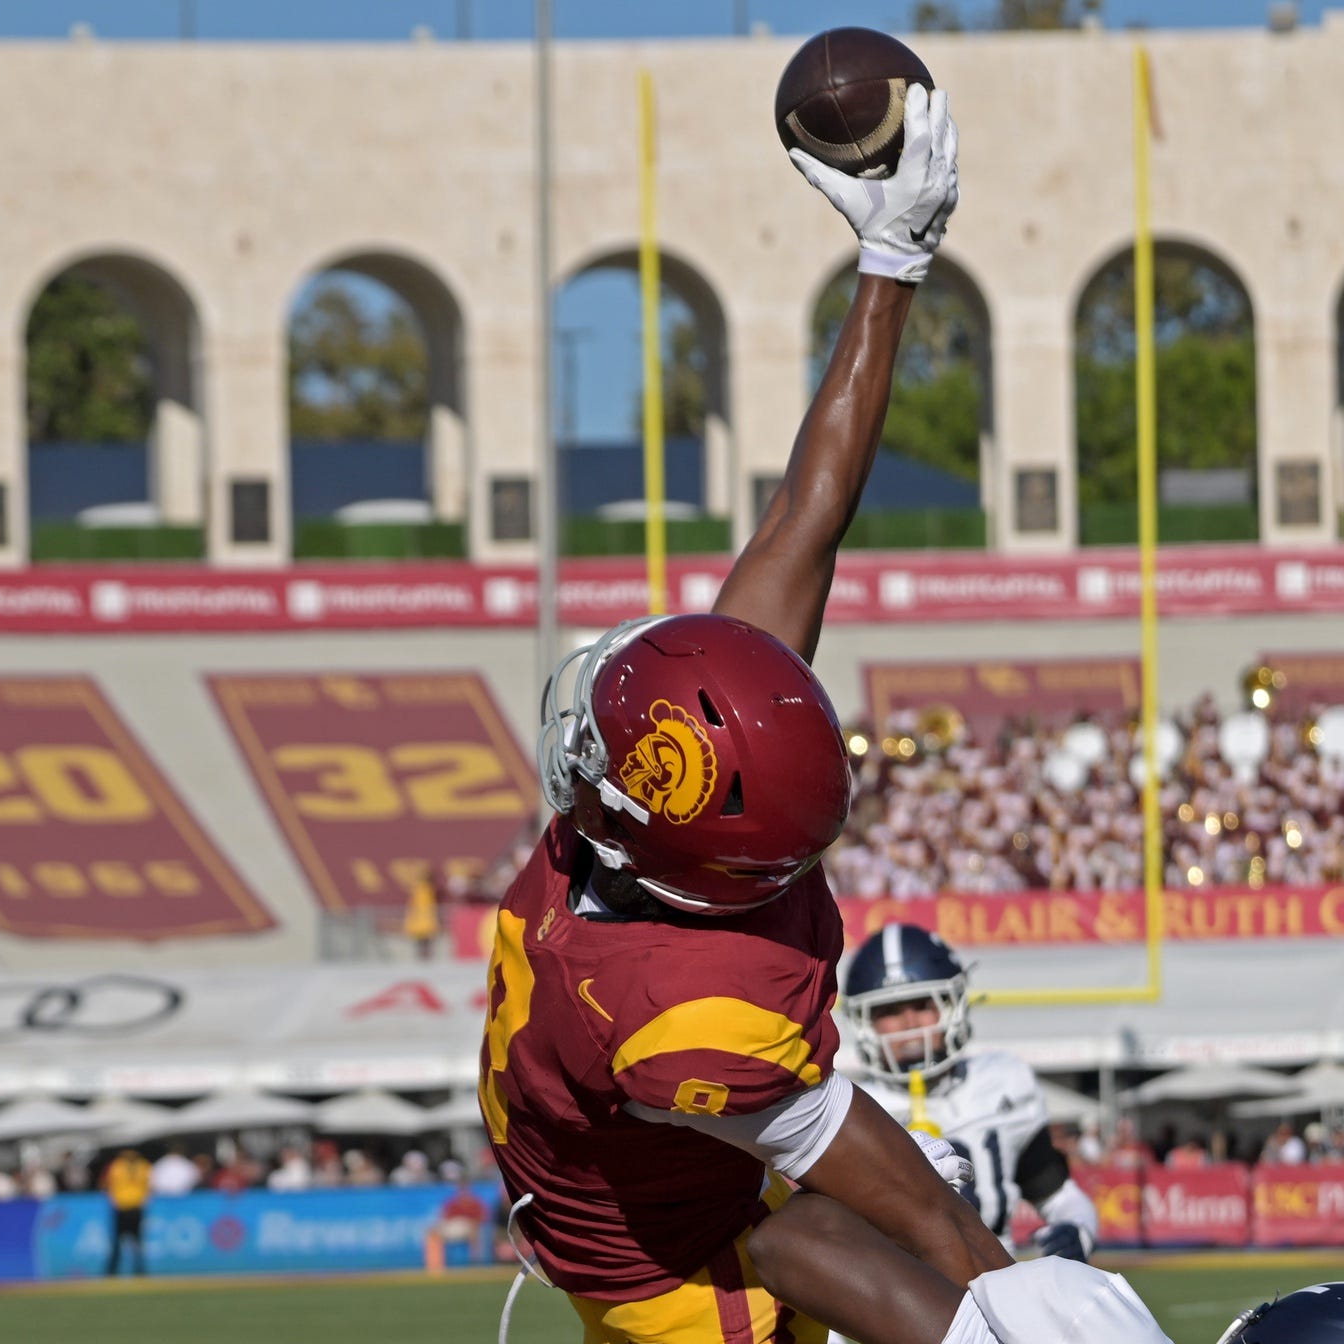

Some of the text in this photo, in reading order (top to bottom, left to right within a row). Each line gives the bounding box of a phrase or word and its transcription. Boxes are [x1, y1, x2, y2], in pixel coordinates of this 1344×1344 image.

[272, 742, 527, 821] 32
[937, 898, 1081, 943] BLAIR
[1094, 895, 1139, 939] &
[1163, 892, 1303, 938] RUTH
[76, 1215, 208, 1258] ACO
